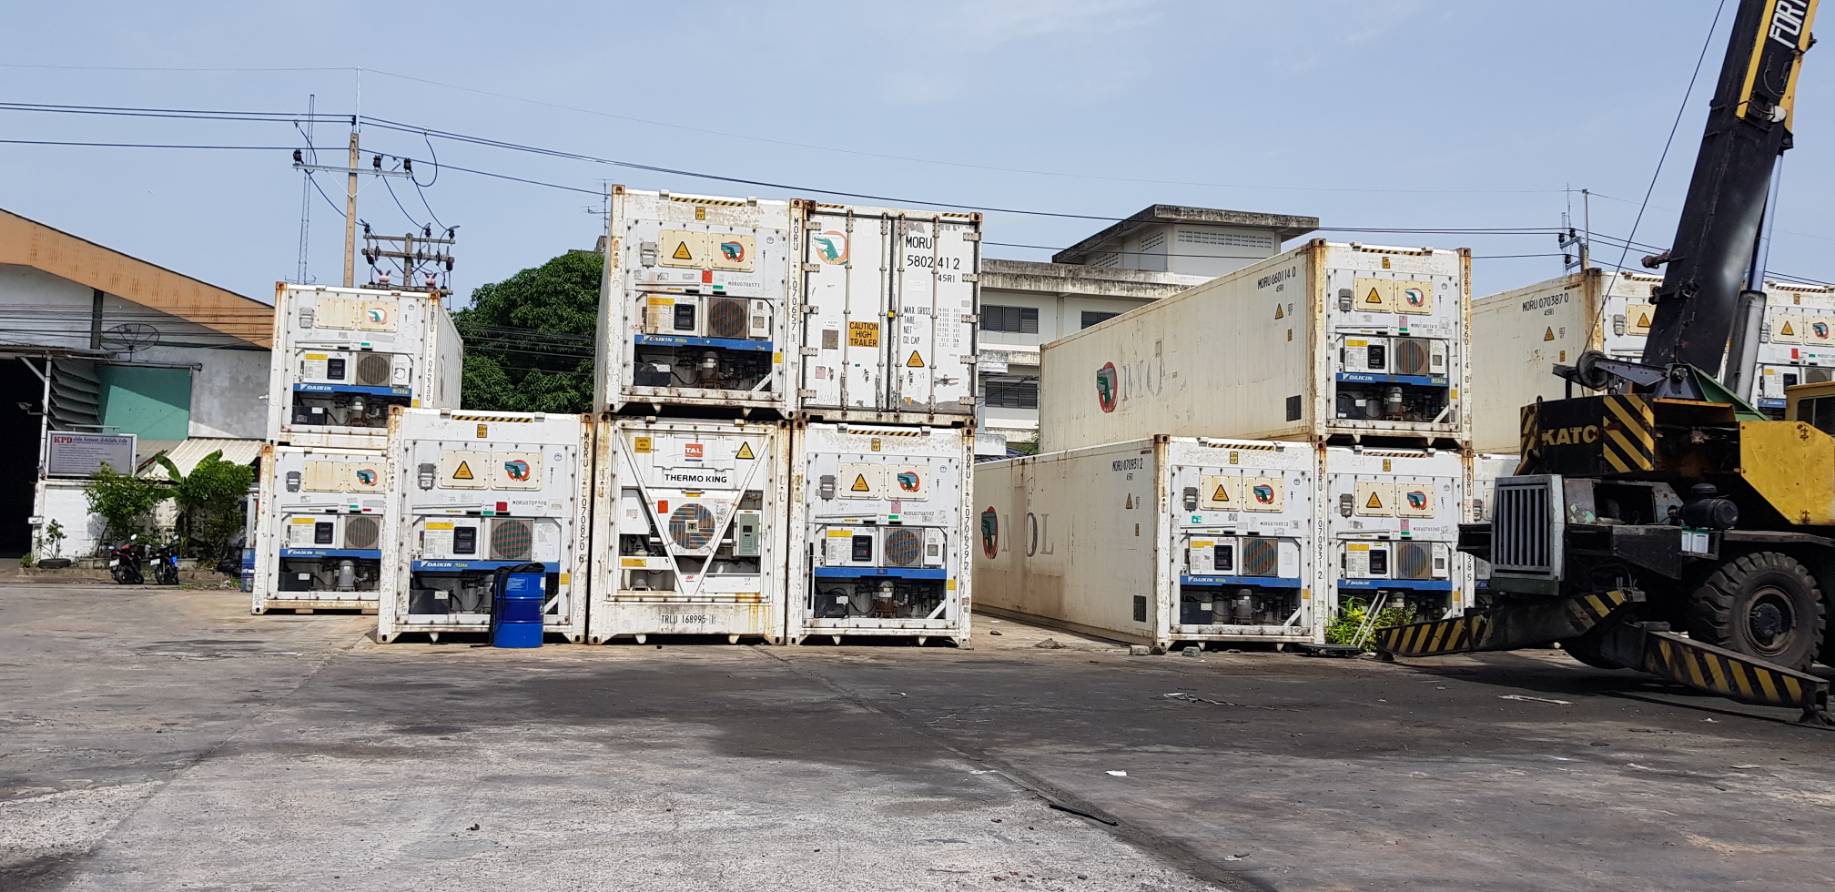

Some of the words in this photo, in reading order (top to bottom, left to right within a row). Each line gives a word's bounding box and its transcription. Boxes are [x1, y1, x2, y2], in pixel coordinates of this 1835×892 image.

[905, 235, 932, 249] MORU
[1522, 299, 1538, 312] MORU
[903, 306, 916, 315] MAX
[904, 316, 916, 325] TARE
[849, 321, 879, 331] CAUTION
[903, 326, 913, 335] NET
[856, 330, 872, 338] HIGH
[850, 338, 877, 347] TRAILER
[54, 436, 72, 444] KPD
[665, 473, 704, 483] THERMO
[705, 475, 727, 484] KING
[661, 614, 678, 625] TRLU
